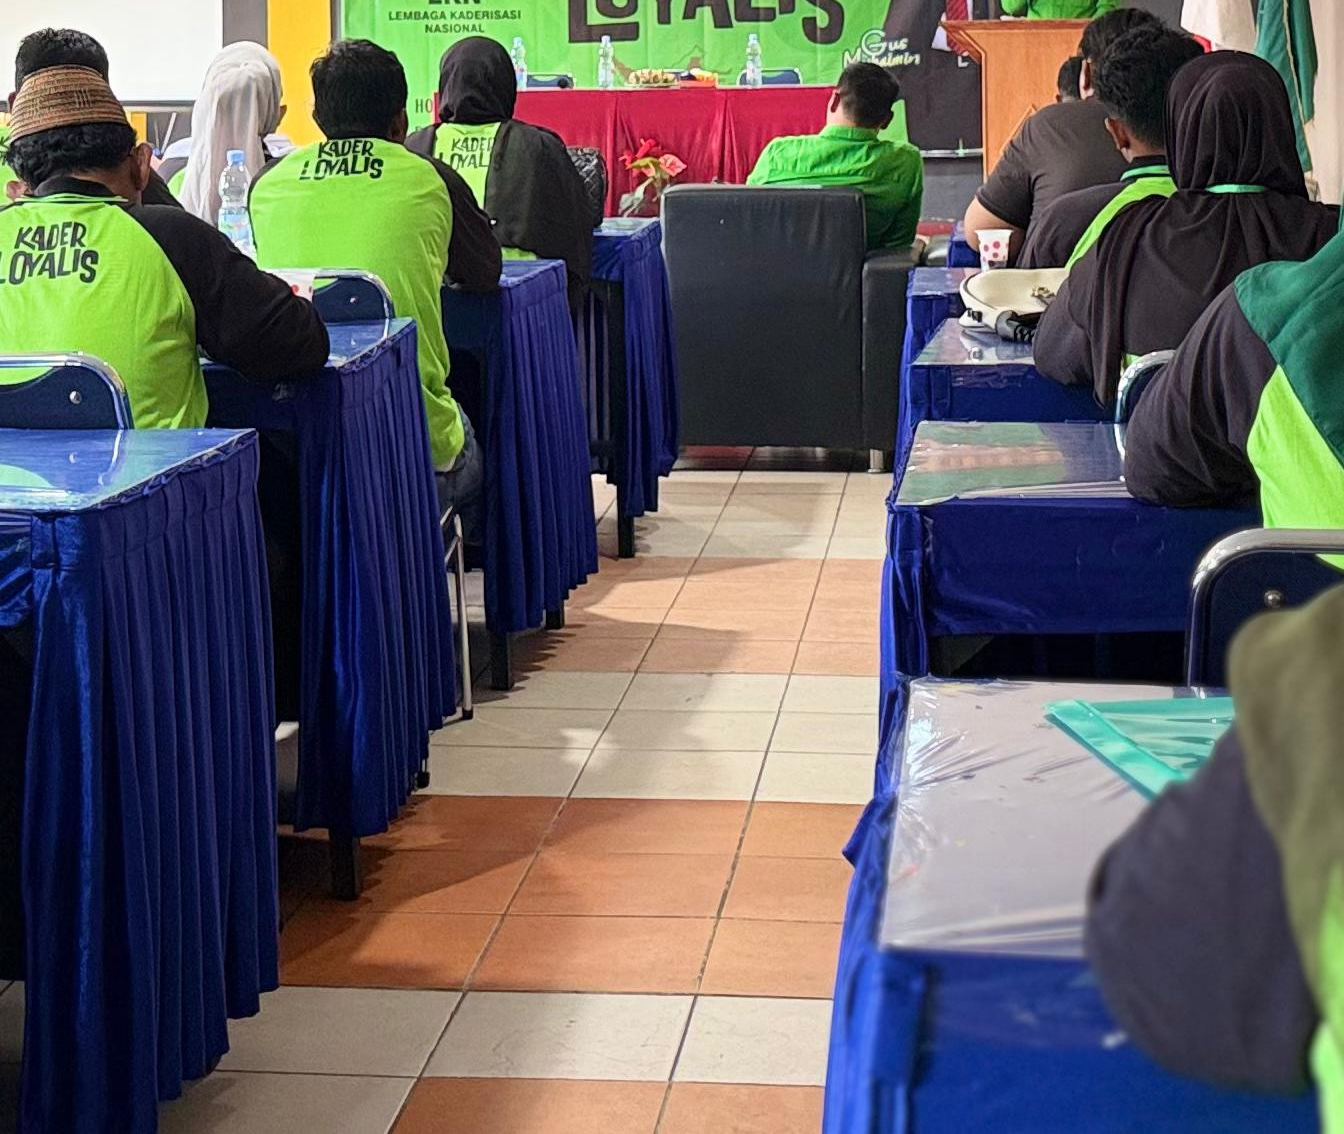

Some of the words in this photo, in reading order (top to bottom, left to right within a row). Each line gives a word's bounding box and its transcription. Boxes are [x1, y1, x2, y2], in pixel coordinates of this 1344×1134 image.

[388, 11, 445, 21] LEMBAGA
[450, 10, 522, 20] KADERISASI
[425, 23, 485, 33] NASIONAL
[861, 29, 909, 56] Gus
[843, 47, 921, 69] Mhaimin
[317, 139, 375, 159] KADER
[299, 154, 385, 180] LOYALIS
[14, 221, 87, 252] KADER
